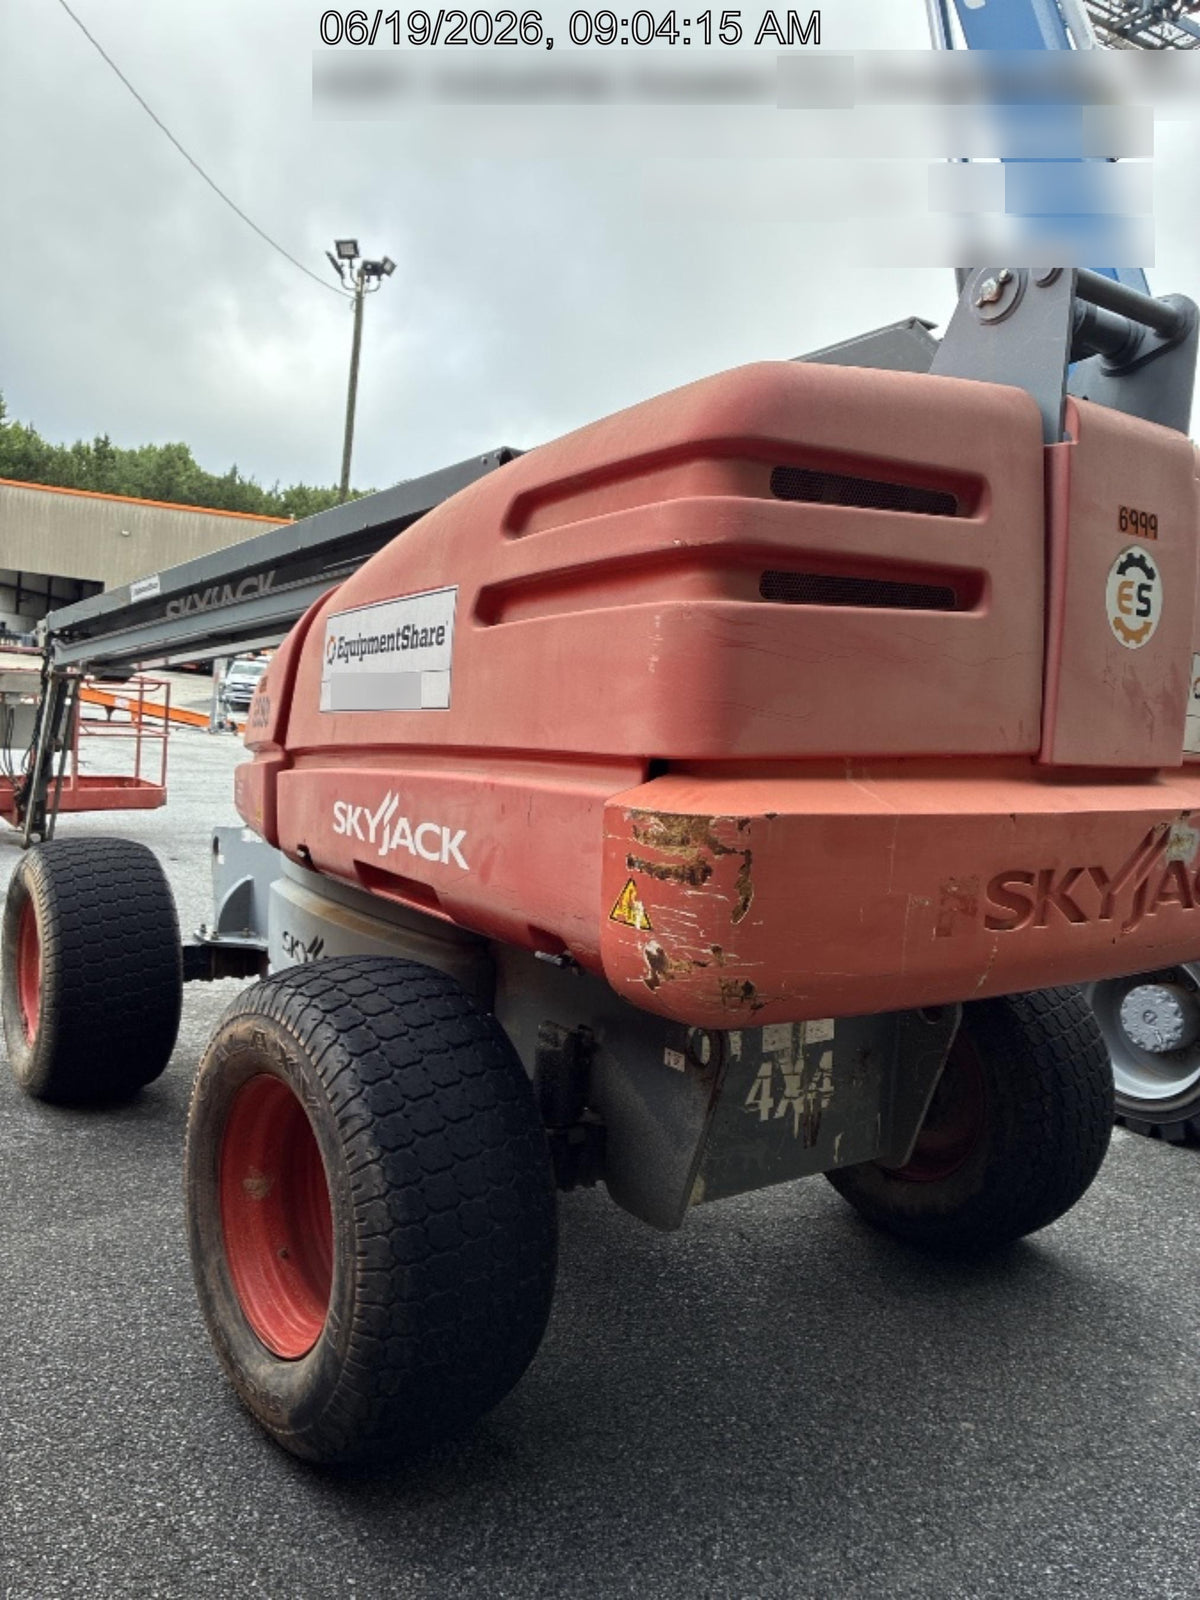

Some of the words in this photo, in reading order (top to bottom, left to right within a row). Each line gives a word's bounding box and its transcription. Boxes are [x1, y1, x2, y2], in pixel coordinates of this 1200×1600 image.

[1118, 506, 1158, 539] 6999
[1116, 580, 1153, 617] ES
[337, 624, 446, 664] EquipmentShare
[333, 789, 470, 871] SKYJACK
[984, 824, 1200, 934] SKYJA
